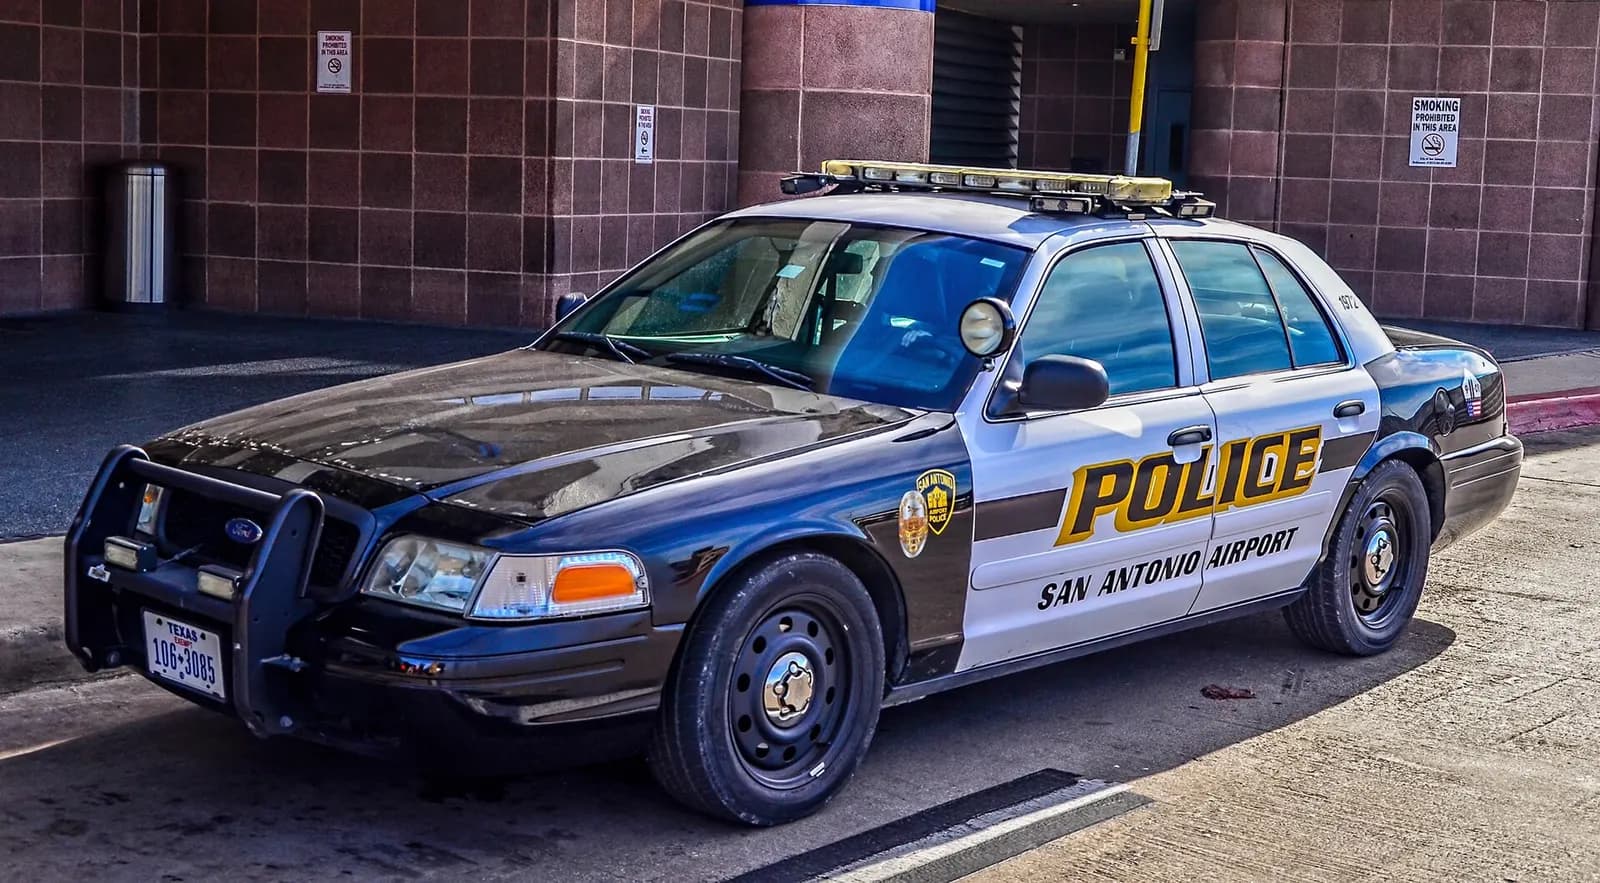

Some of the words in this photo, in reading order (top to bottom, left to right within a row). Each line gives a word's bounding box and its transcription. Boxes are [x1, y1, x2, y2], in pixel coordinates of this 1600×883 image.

[1414, 100, 1459, 112] SMOKING
[1415, 113, 1456, 122] PROHIBITED
[1413, 123, 1420, 131] IN
[1422, 123, 1437, 132] THIS
[1438, 124, 1457, 132] AREA
[1339, 295, 1359, 310] 1972
[918, 476, 930, 491] SAN
[1055, 426, 1322, 546] POLICE
[929, 514, 947, 523] POLICE
[1037, 574, 1092, 610] SAN
[1097, 550, 1201, 597] ANTONIO
[1206, 526, 1299, 570] AIRPORT
[167, 621, 198, 642] TEXAS
